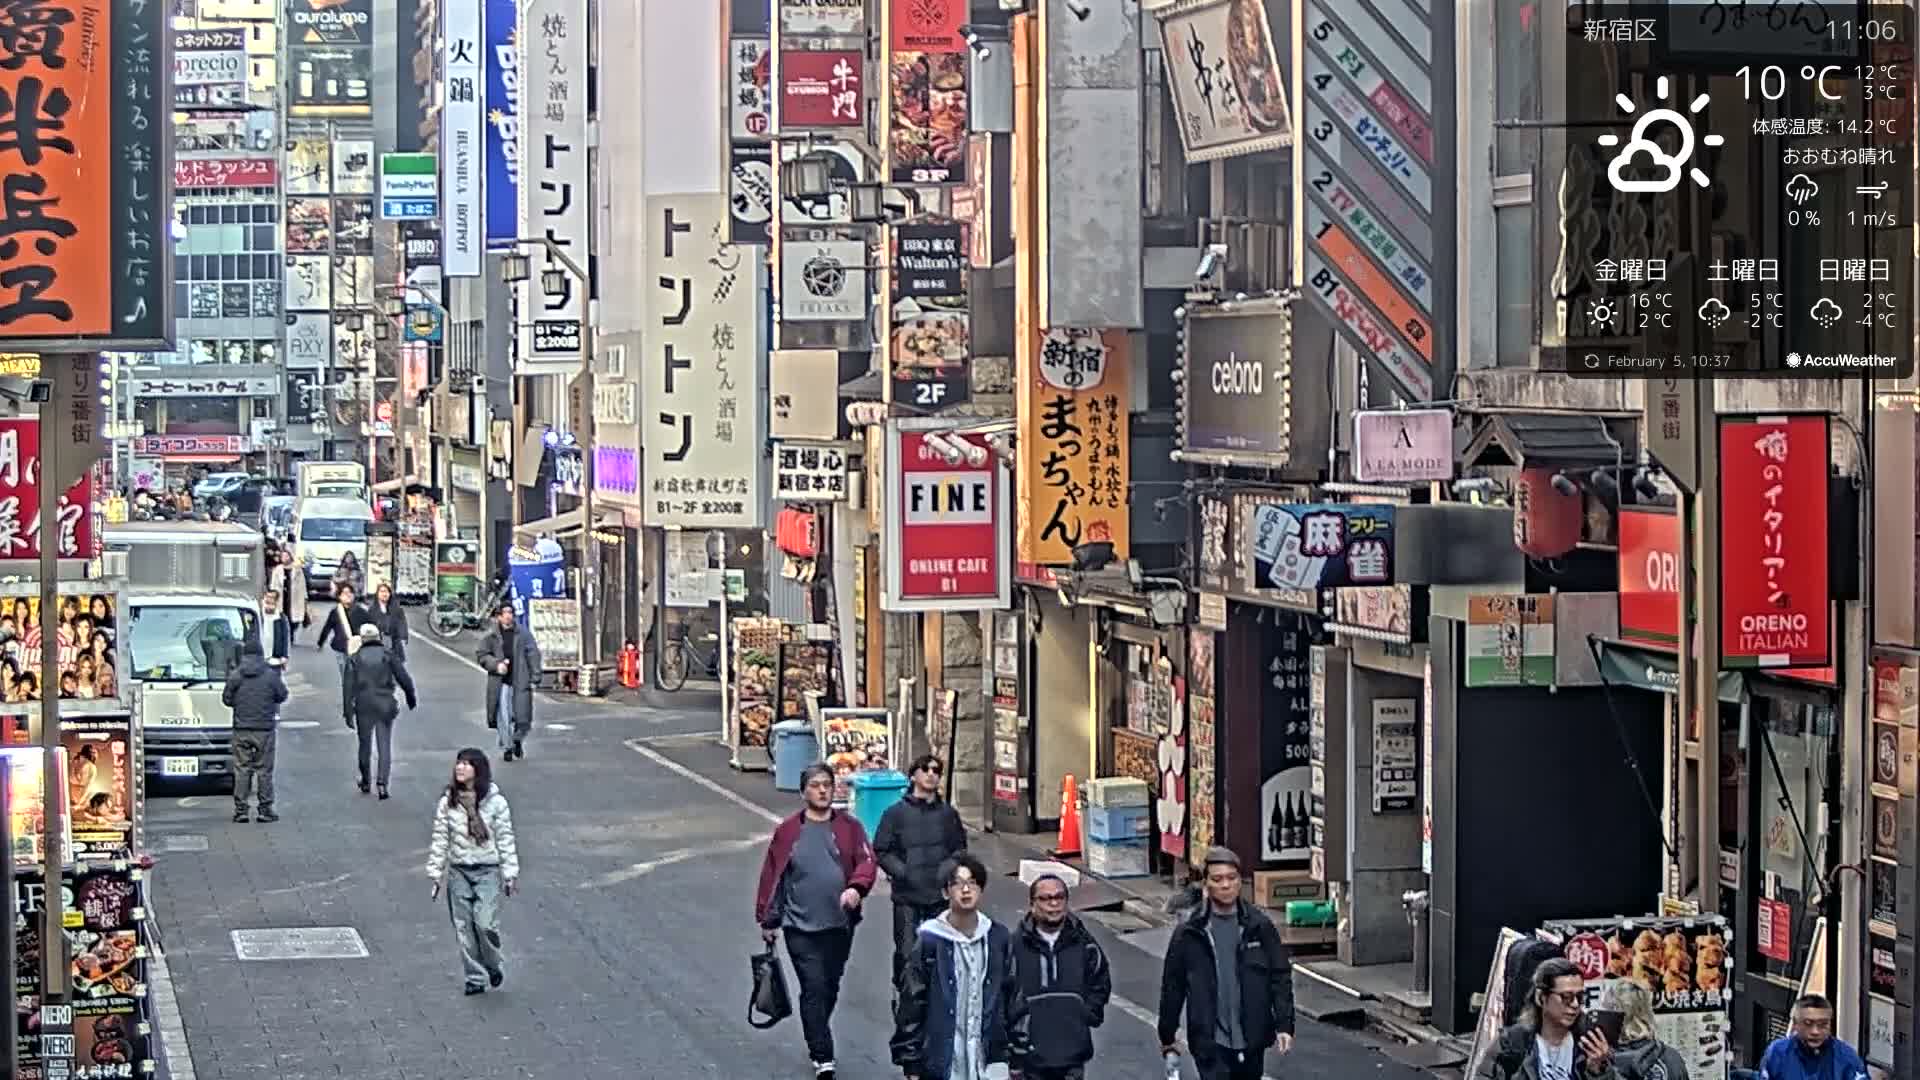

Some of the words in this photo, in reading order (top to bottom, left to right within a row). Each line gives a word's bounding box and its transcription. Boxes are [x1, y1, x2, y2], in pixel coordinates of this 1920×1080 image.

[1313, 21, 1334, 42] 5
[449, 38, 475, 104] 火鍋
[541, 13, 569, 123] 焼とん酒場
[830, 57, 859, 120] 牛門
[1313, 72, 1333, 91] 4
[1313, 121, 1333, 142] 3
[911, 168, 951, 183] 3F
[1312, 170, 1334, 193] 2
[1315, 220, 1334, 240] 1
[900, 254, 960, 271] Walton's
[1311, 267, 1341, 298] B1
[658, 207, 692, 463] トントン
[711, 322, 738, 443] 焼とん酒場
[1211, 352, 1263, 394] celona
[915, 383, 946, 404] 2F
[779, 448, 843, 470] 酒場心
[778, 473, 843, 492] 新宿本店
[1040, 395, 1085, 549] まっちゃん
[911, 483, 986, 513] FINE
[701, 502, 744, 516] 全200席
[1754, 429, 1789, 603] 俺のイタリアン
[1349, 517, 1389, 535] フリー
[909, 558, 954, 575] ONLINE
[957, 558, 989, 574] CAFE
[940, 577, 958, 593] B1
[1740, 614, 1808, 633] ORENO
[1739, 632, 1809, 651] ITALIAN
